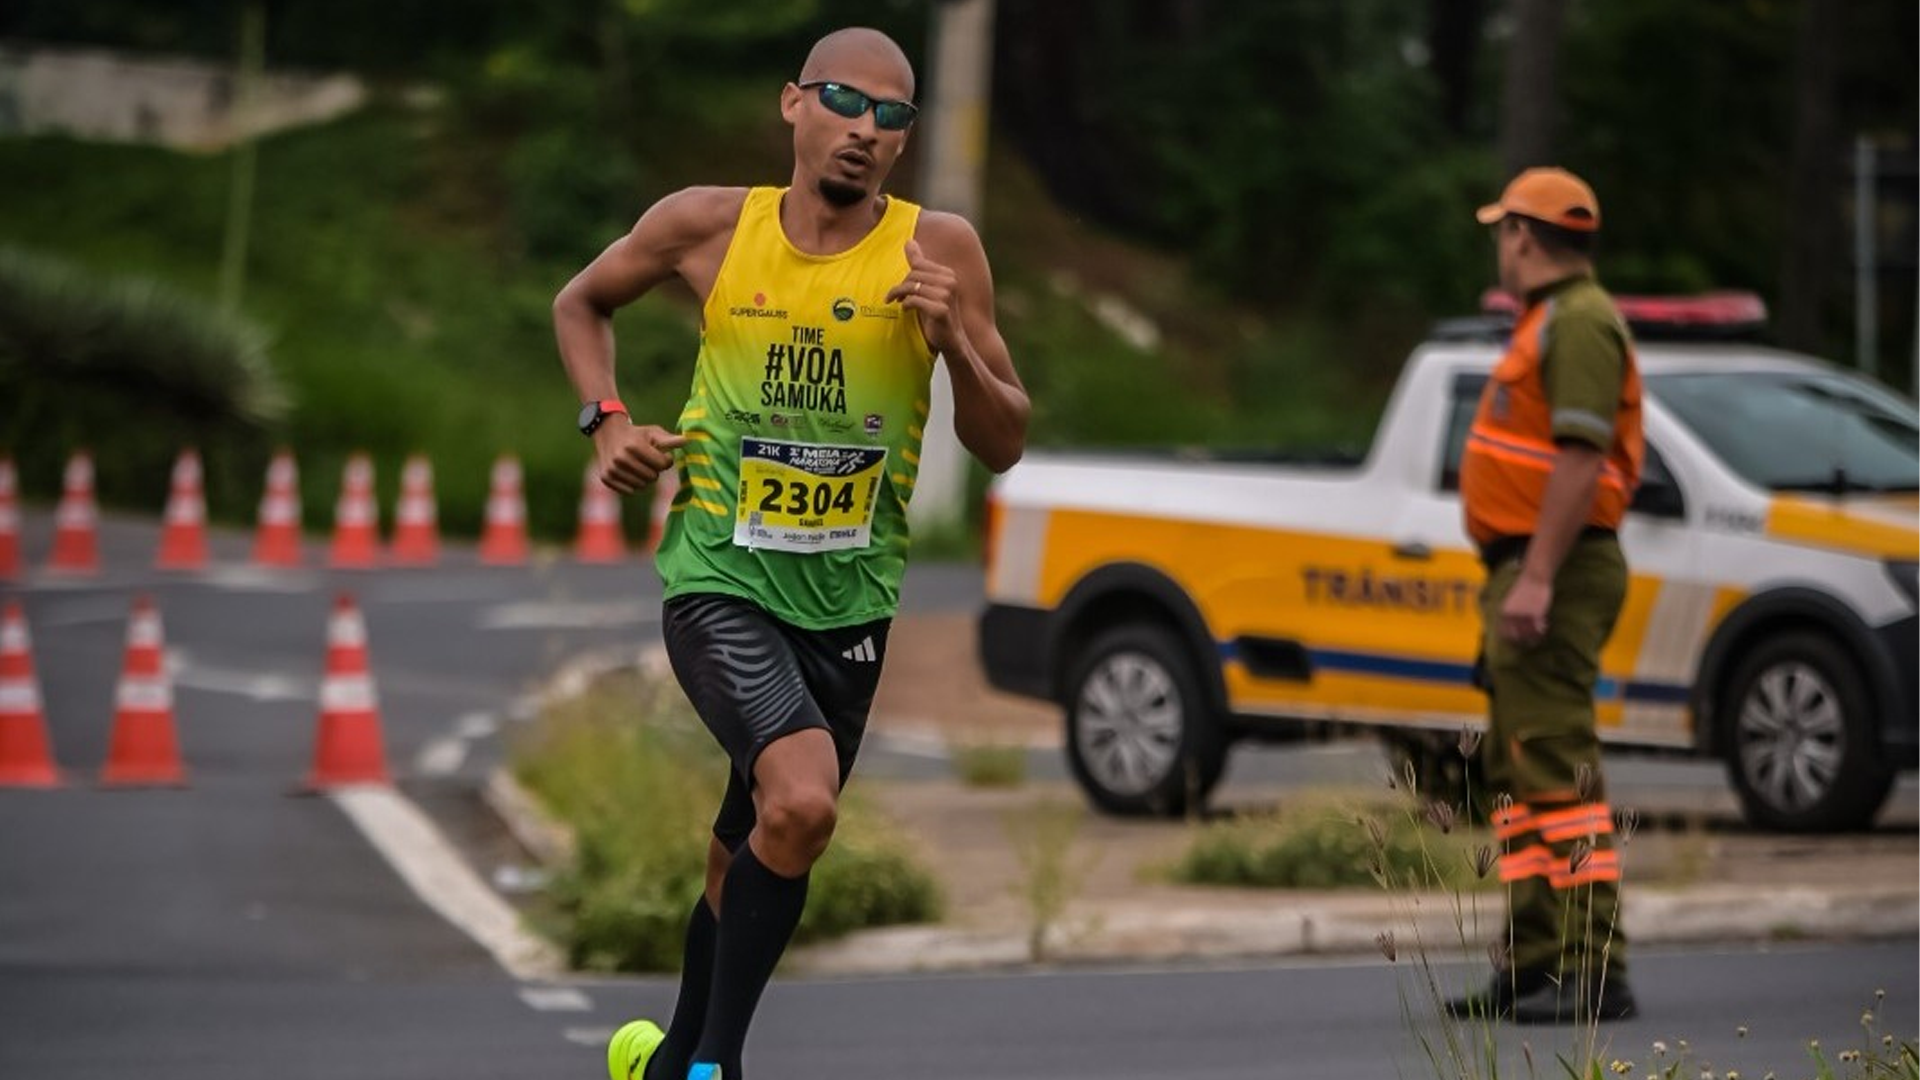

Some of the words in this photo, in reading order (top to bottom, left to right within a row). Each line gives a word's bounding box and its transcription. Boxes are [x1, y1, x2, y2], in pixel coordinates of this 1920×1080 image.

[792, 326, 825, 346] TIME
[765, 343, 845, 387] #VOA
[761, 381, 847, 414] SAMUKA
[757, 444, 781, 456] 21K
[802, 448, 840, 459] MEIA
[759, 478, 854, 516] 2304
[1302, 566, 1478, 614] TRÂNSIT
